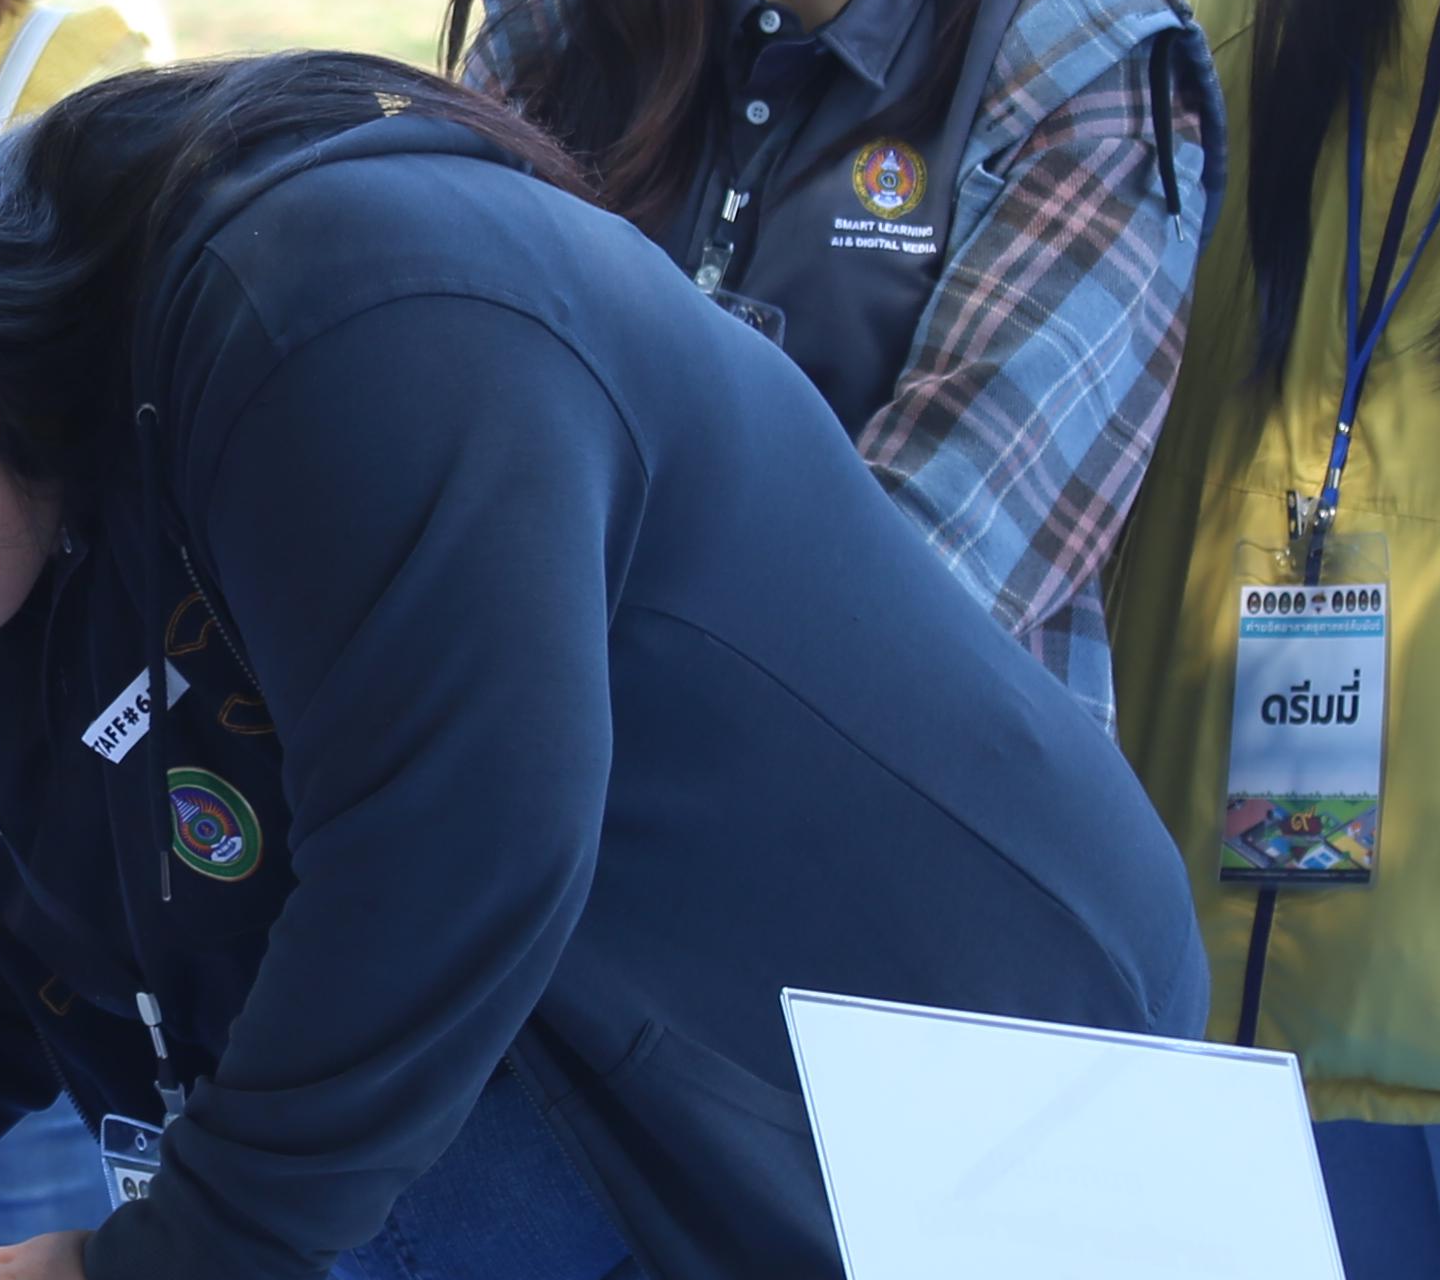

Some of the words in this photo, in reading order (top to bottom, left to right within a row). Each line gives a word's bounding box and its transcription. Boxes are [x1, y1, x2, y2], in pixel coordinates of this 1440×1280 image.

[834, 218, 876, 231] SMART
[878, 222, 934, 238] LEARNING
[855, 236, 900, 251] DIGITAL
[1261, 669, 1361, 726] ดรีมมี่
